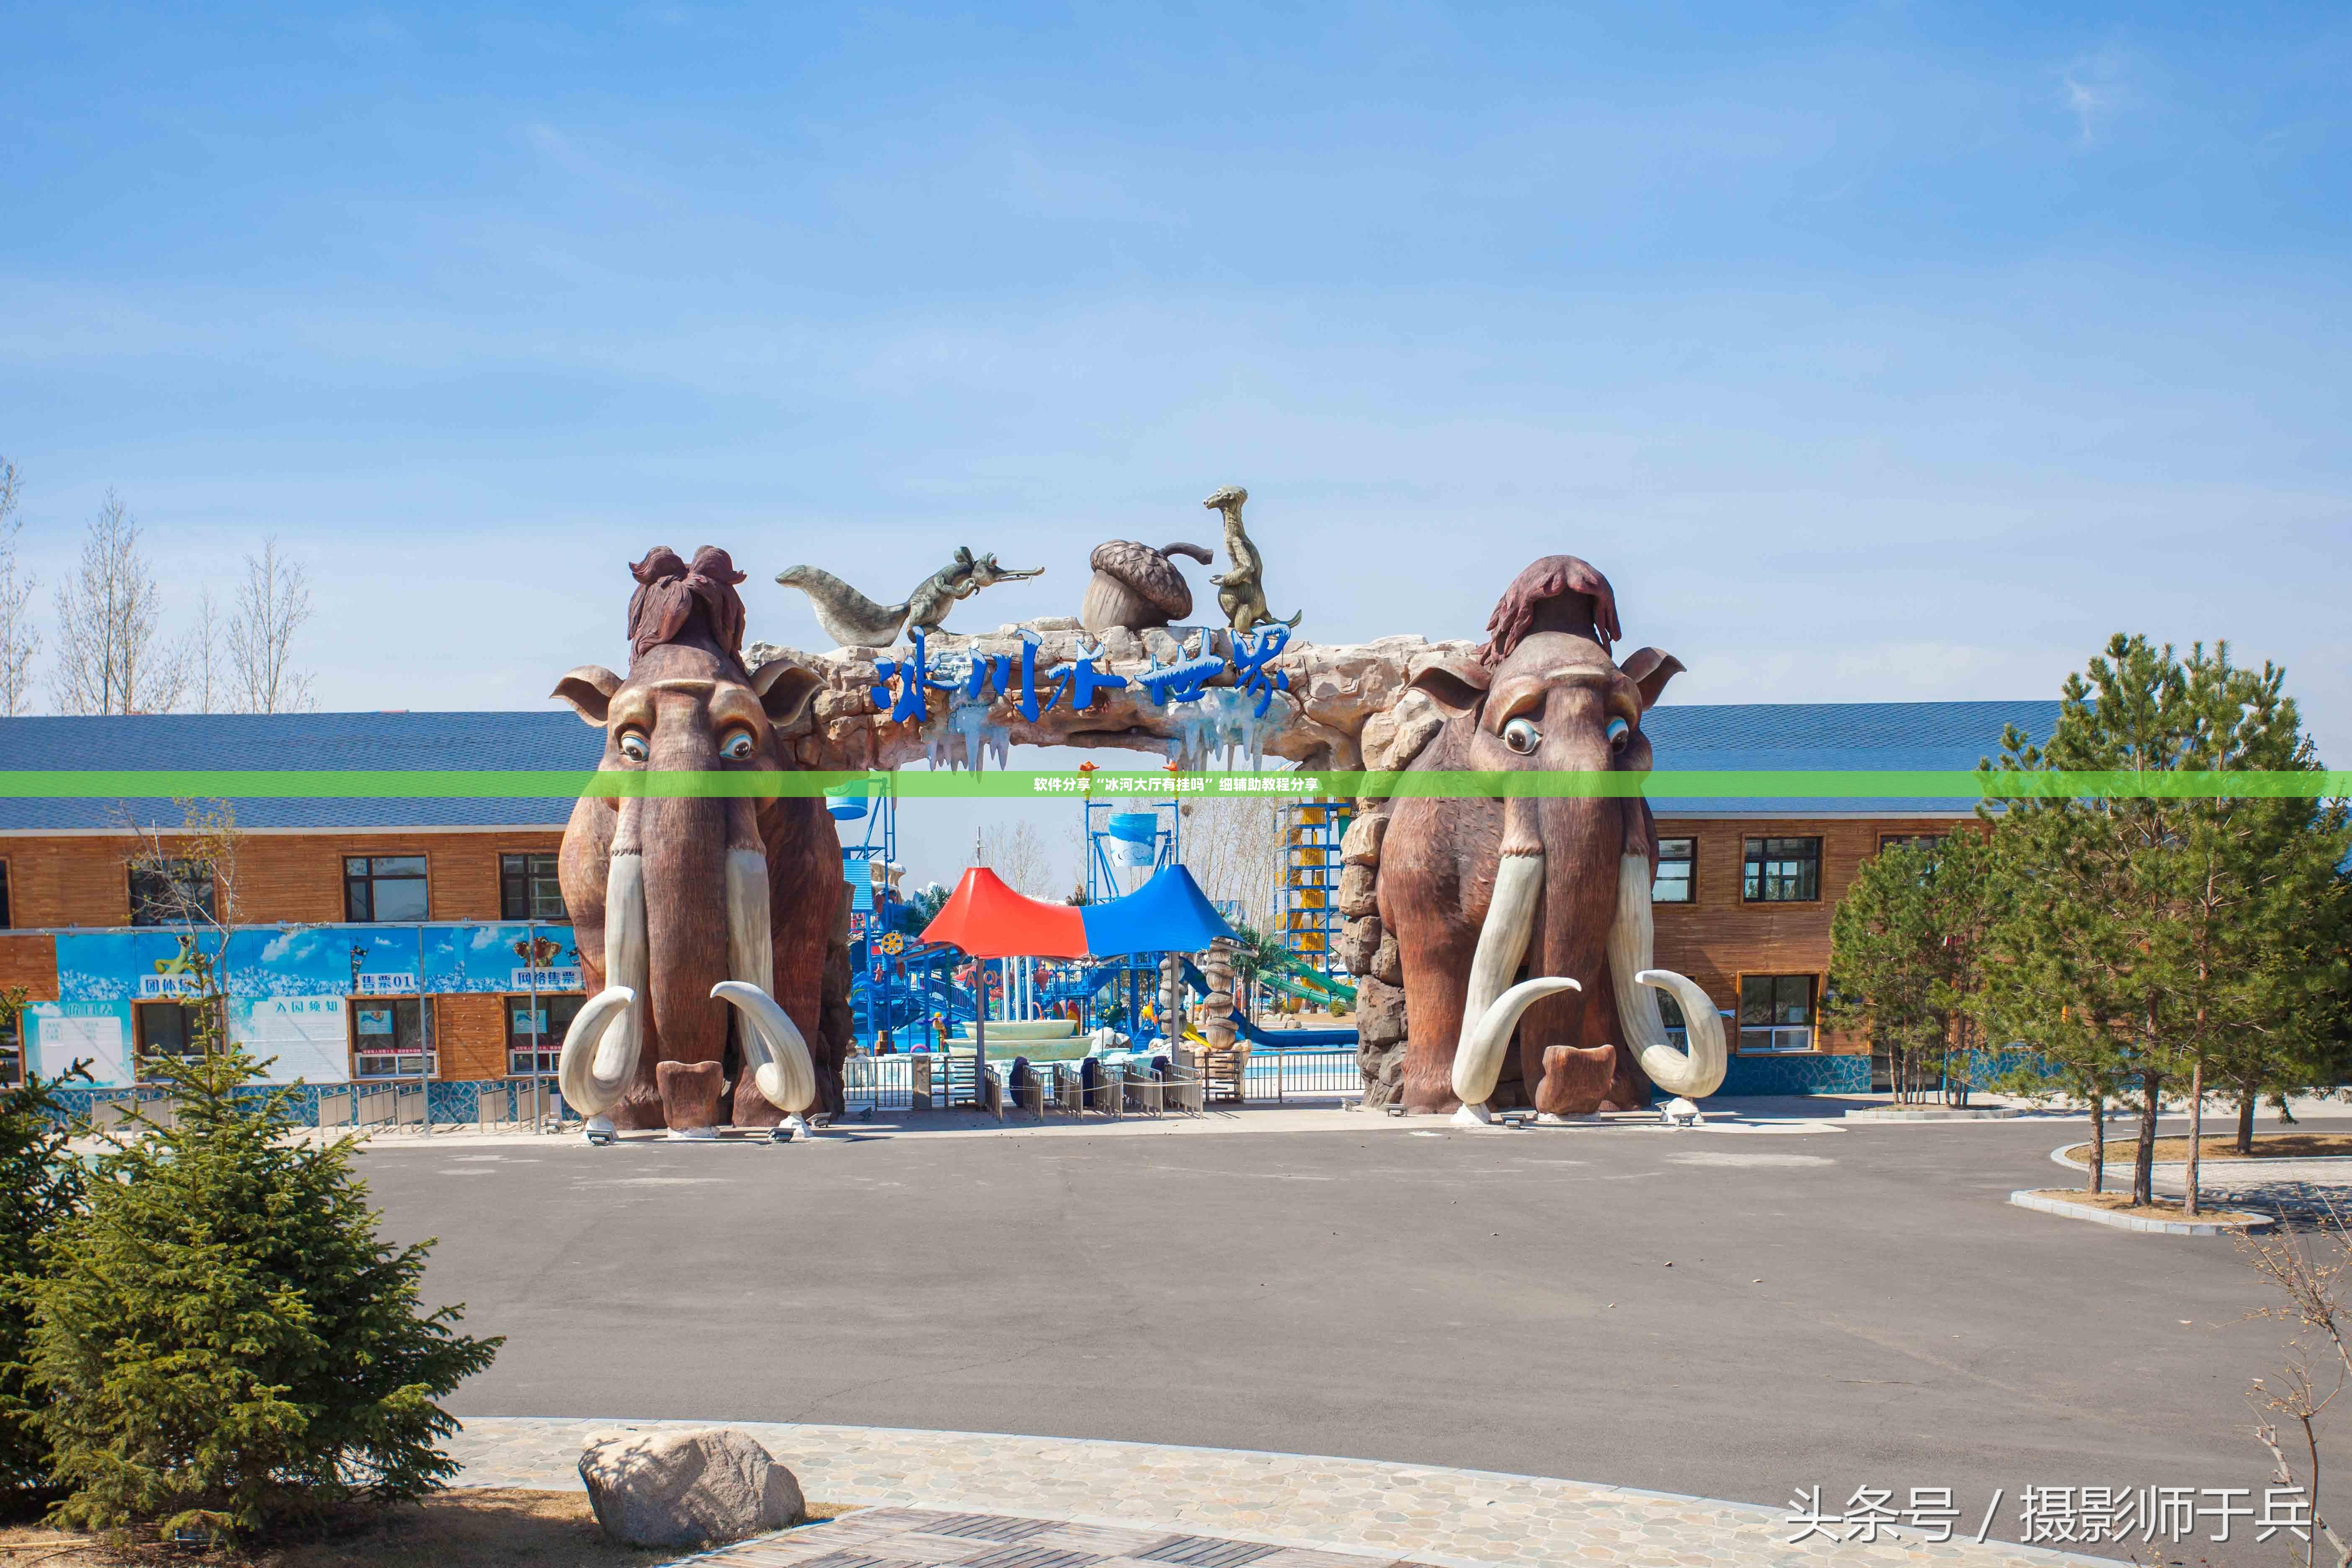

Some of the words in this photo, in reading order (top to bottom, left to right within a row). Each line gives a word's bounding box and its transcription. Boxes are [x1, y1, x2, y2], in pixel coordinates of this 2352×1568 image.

[870, 624, 1291, 723] 冰川水世界
[363, 975, 410, 988] 售票01
[518, 971, 575, 985] 网络售票
[965, 970, 1015, 988] AOH
[276, 1000, 338, 1012] 入园须知
